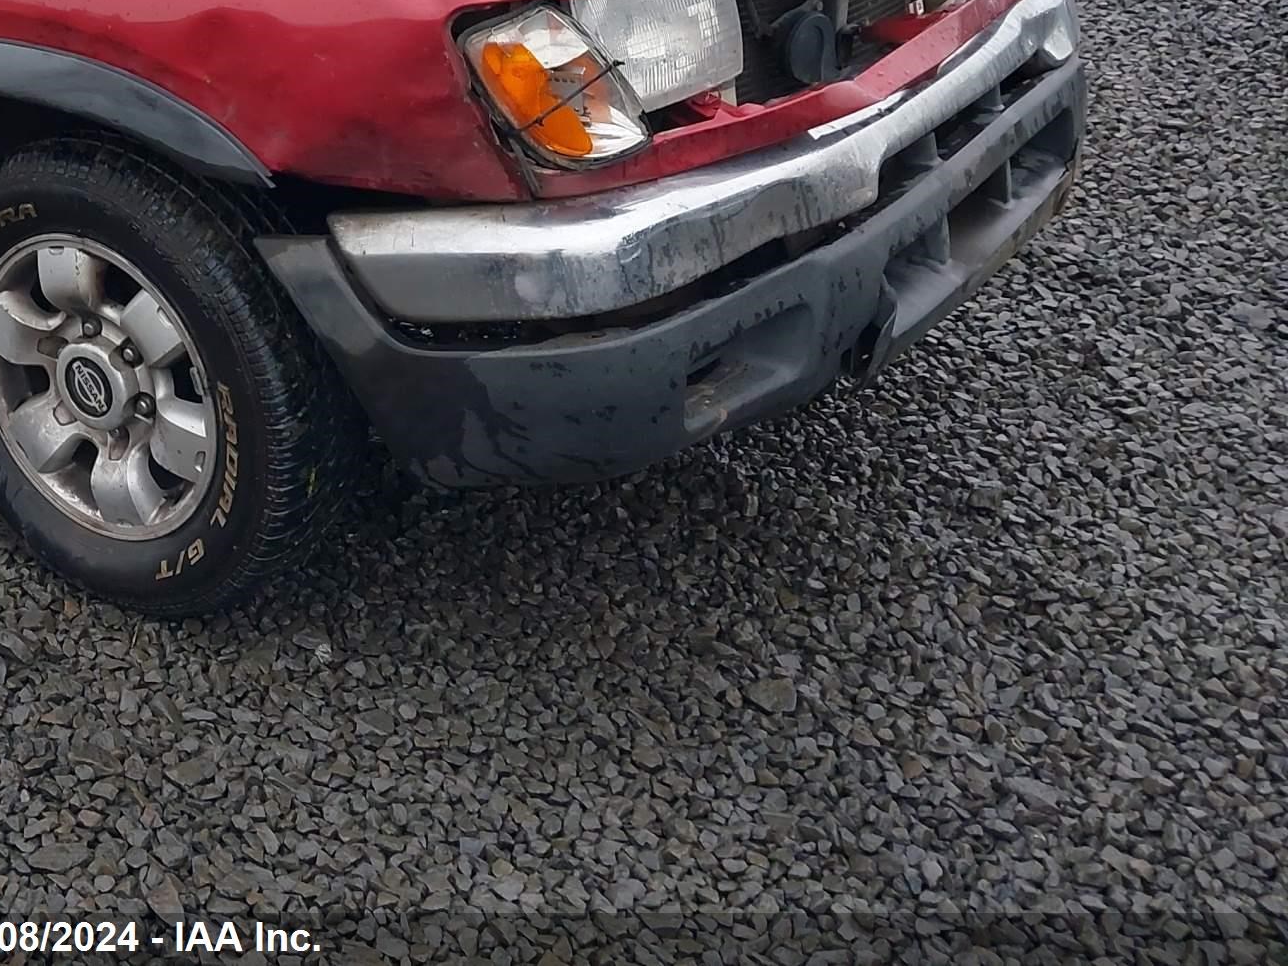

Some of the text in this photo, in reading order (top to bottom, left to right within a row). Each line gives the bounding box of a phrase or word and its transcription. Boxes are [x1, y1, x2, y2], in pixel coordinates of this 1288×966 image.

[75, 365, 105, 410] NISSAN
[155, 381, 240, 582] RADIAL G/T
